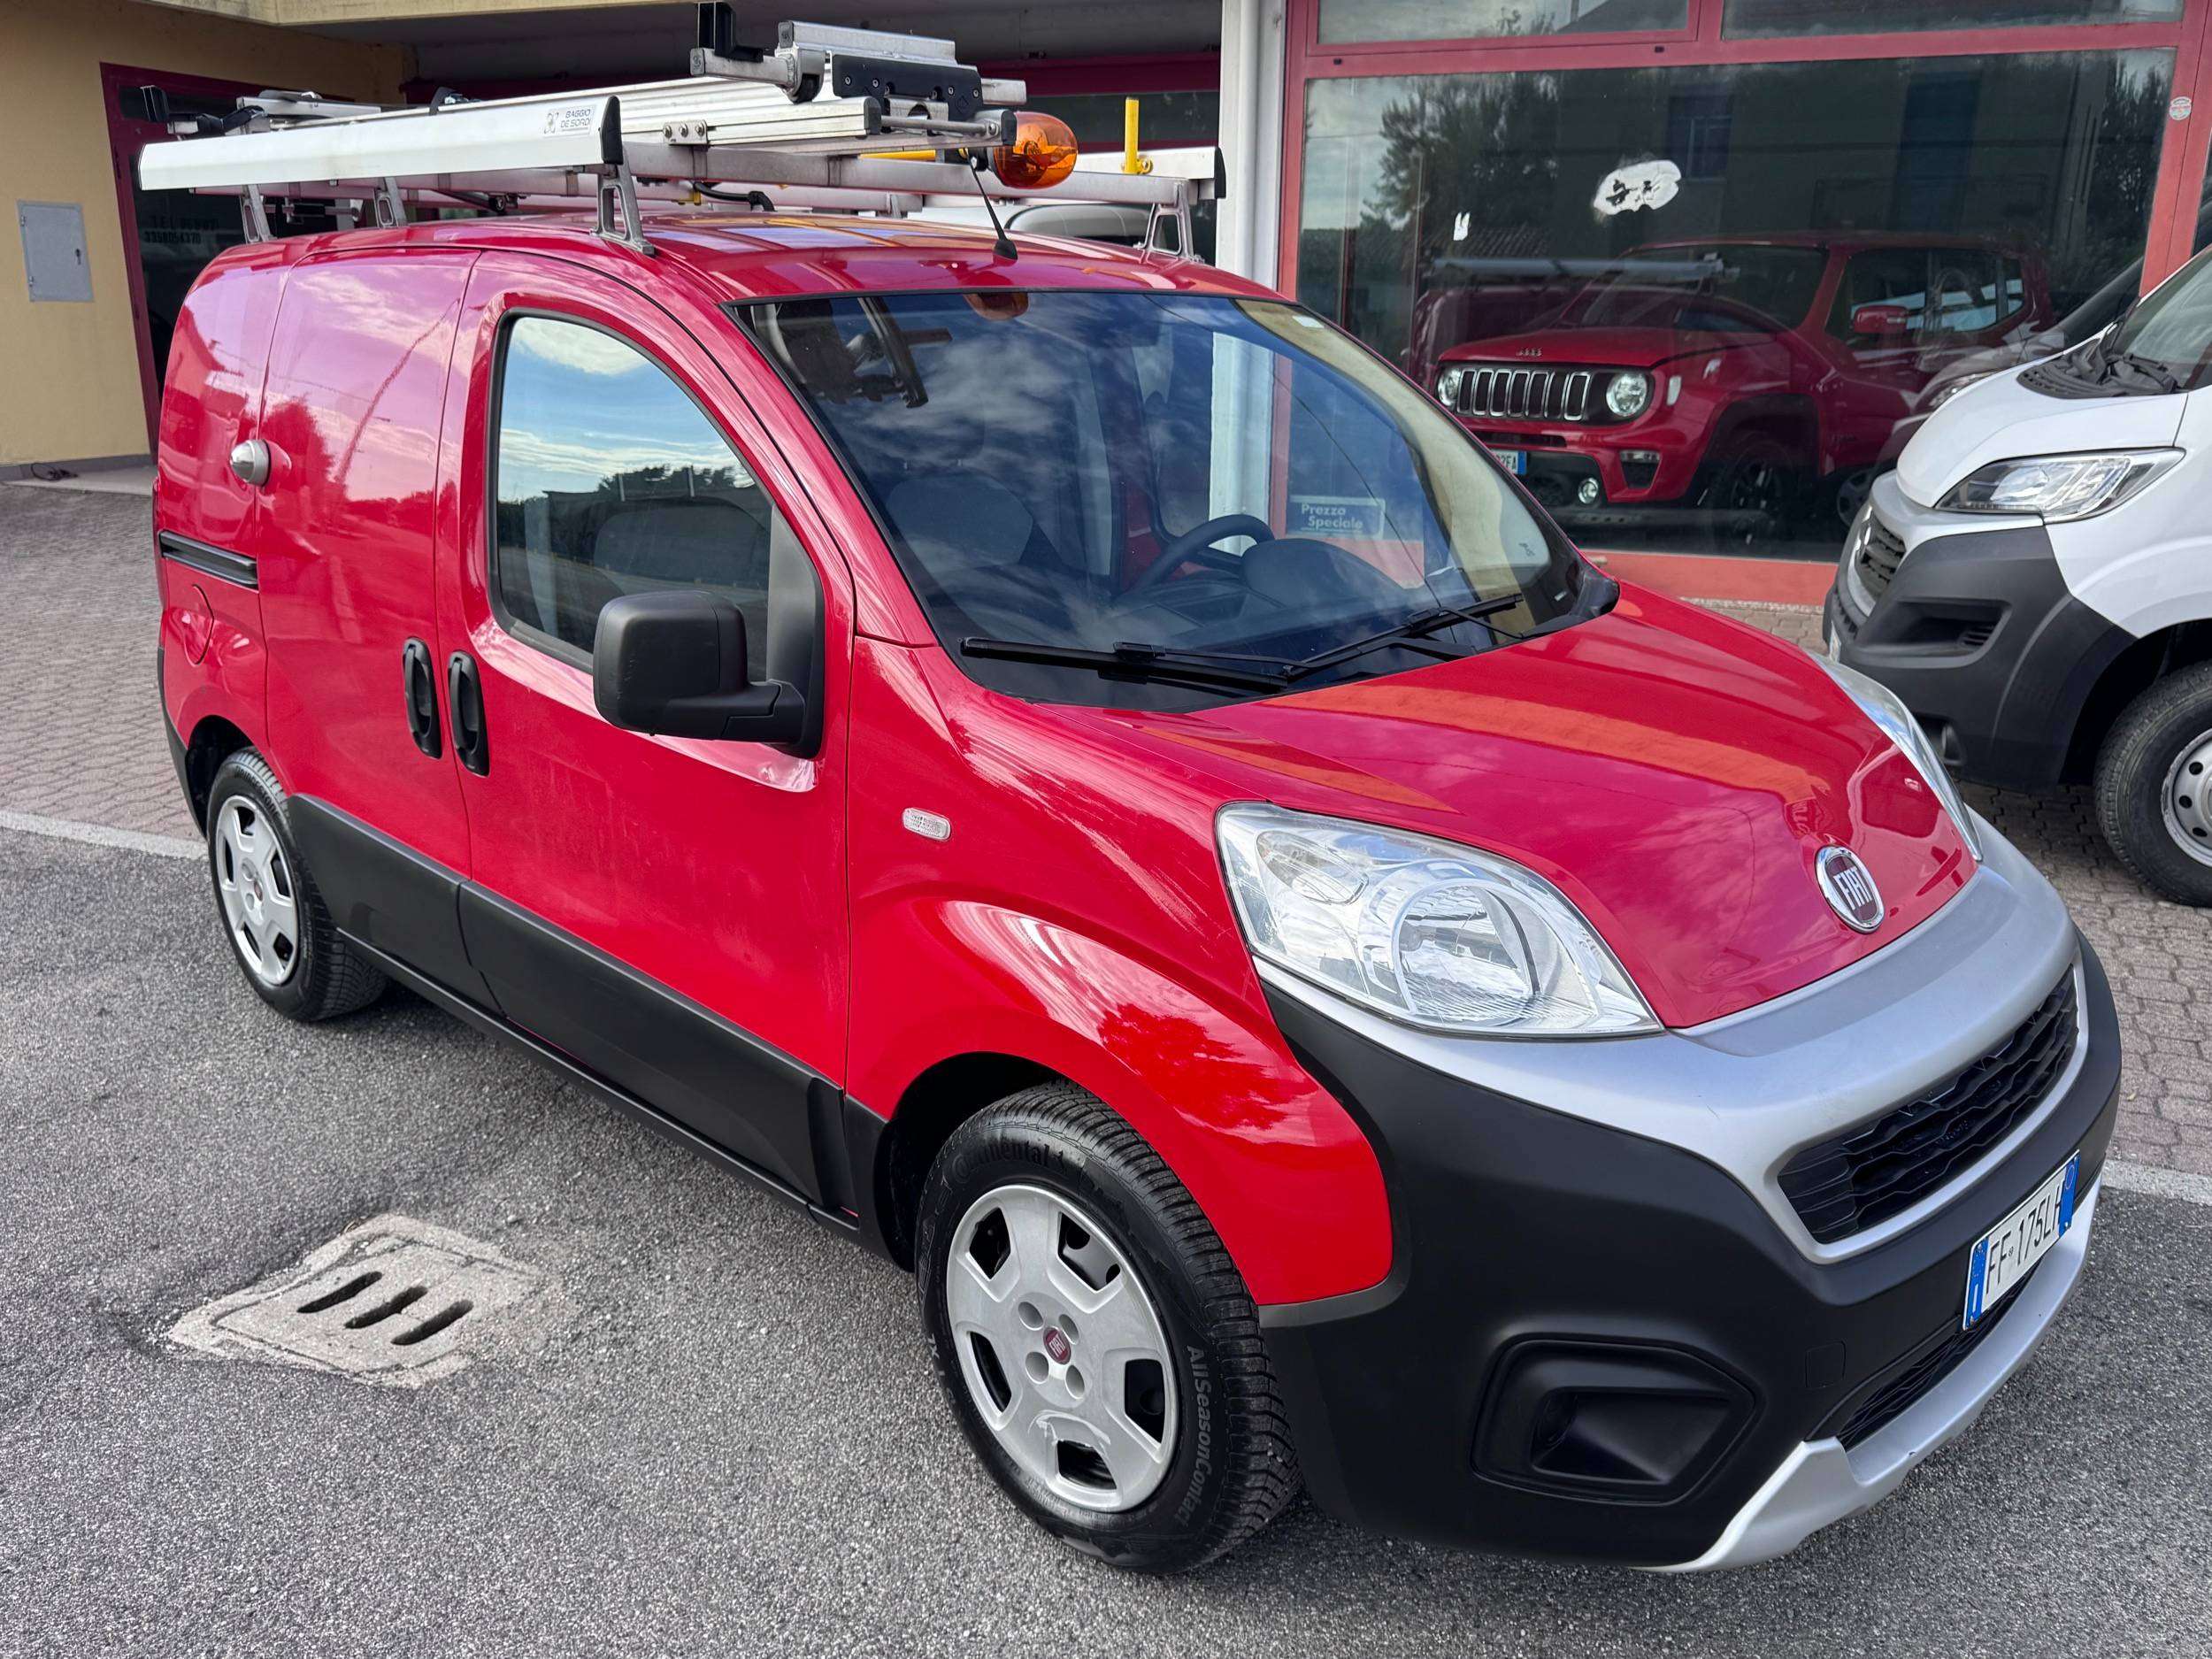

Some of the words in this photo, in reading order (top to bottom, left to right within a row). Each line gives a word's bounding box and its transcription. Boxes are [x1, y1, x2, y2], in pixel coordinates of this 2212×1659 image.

[1302, 502, 1346, 516] Prezzo
[1308, 515, 1363, 531] Speciale
[1832, 865, 1874, 910] FIAT
[1985, 1230, 2012, 1295] FF
[1048, 1333, 1067, 1358] FIAT
[1174, 1344, 1213, 1528] AllSeasonContact
